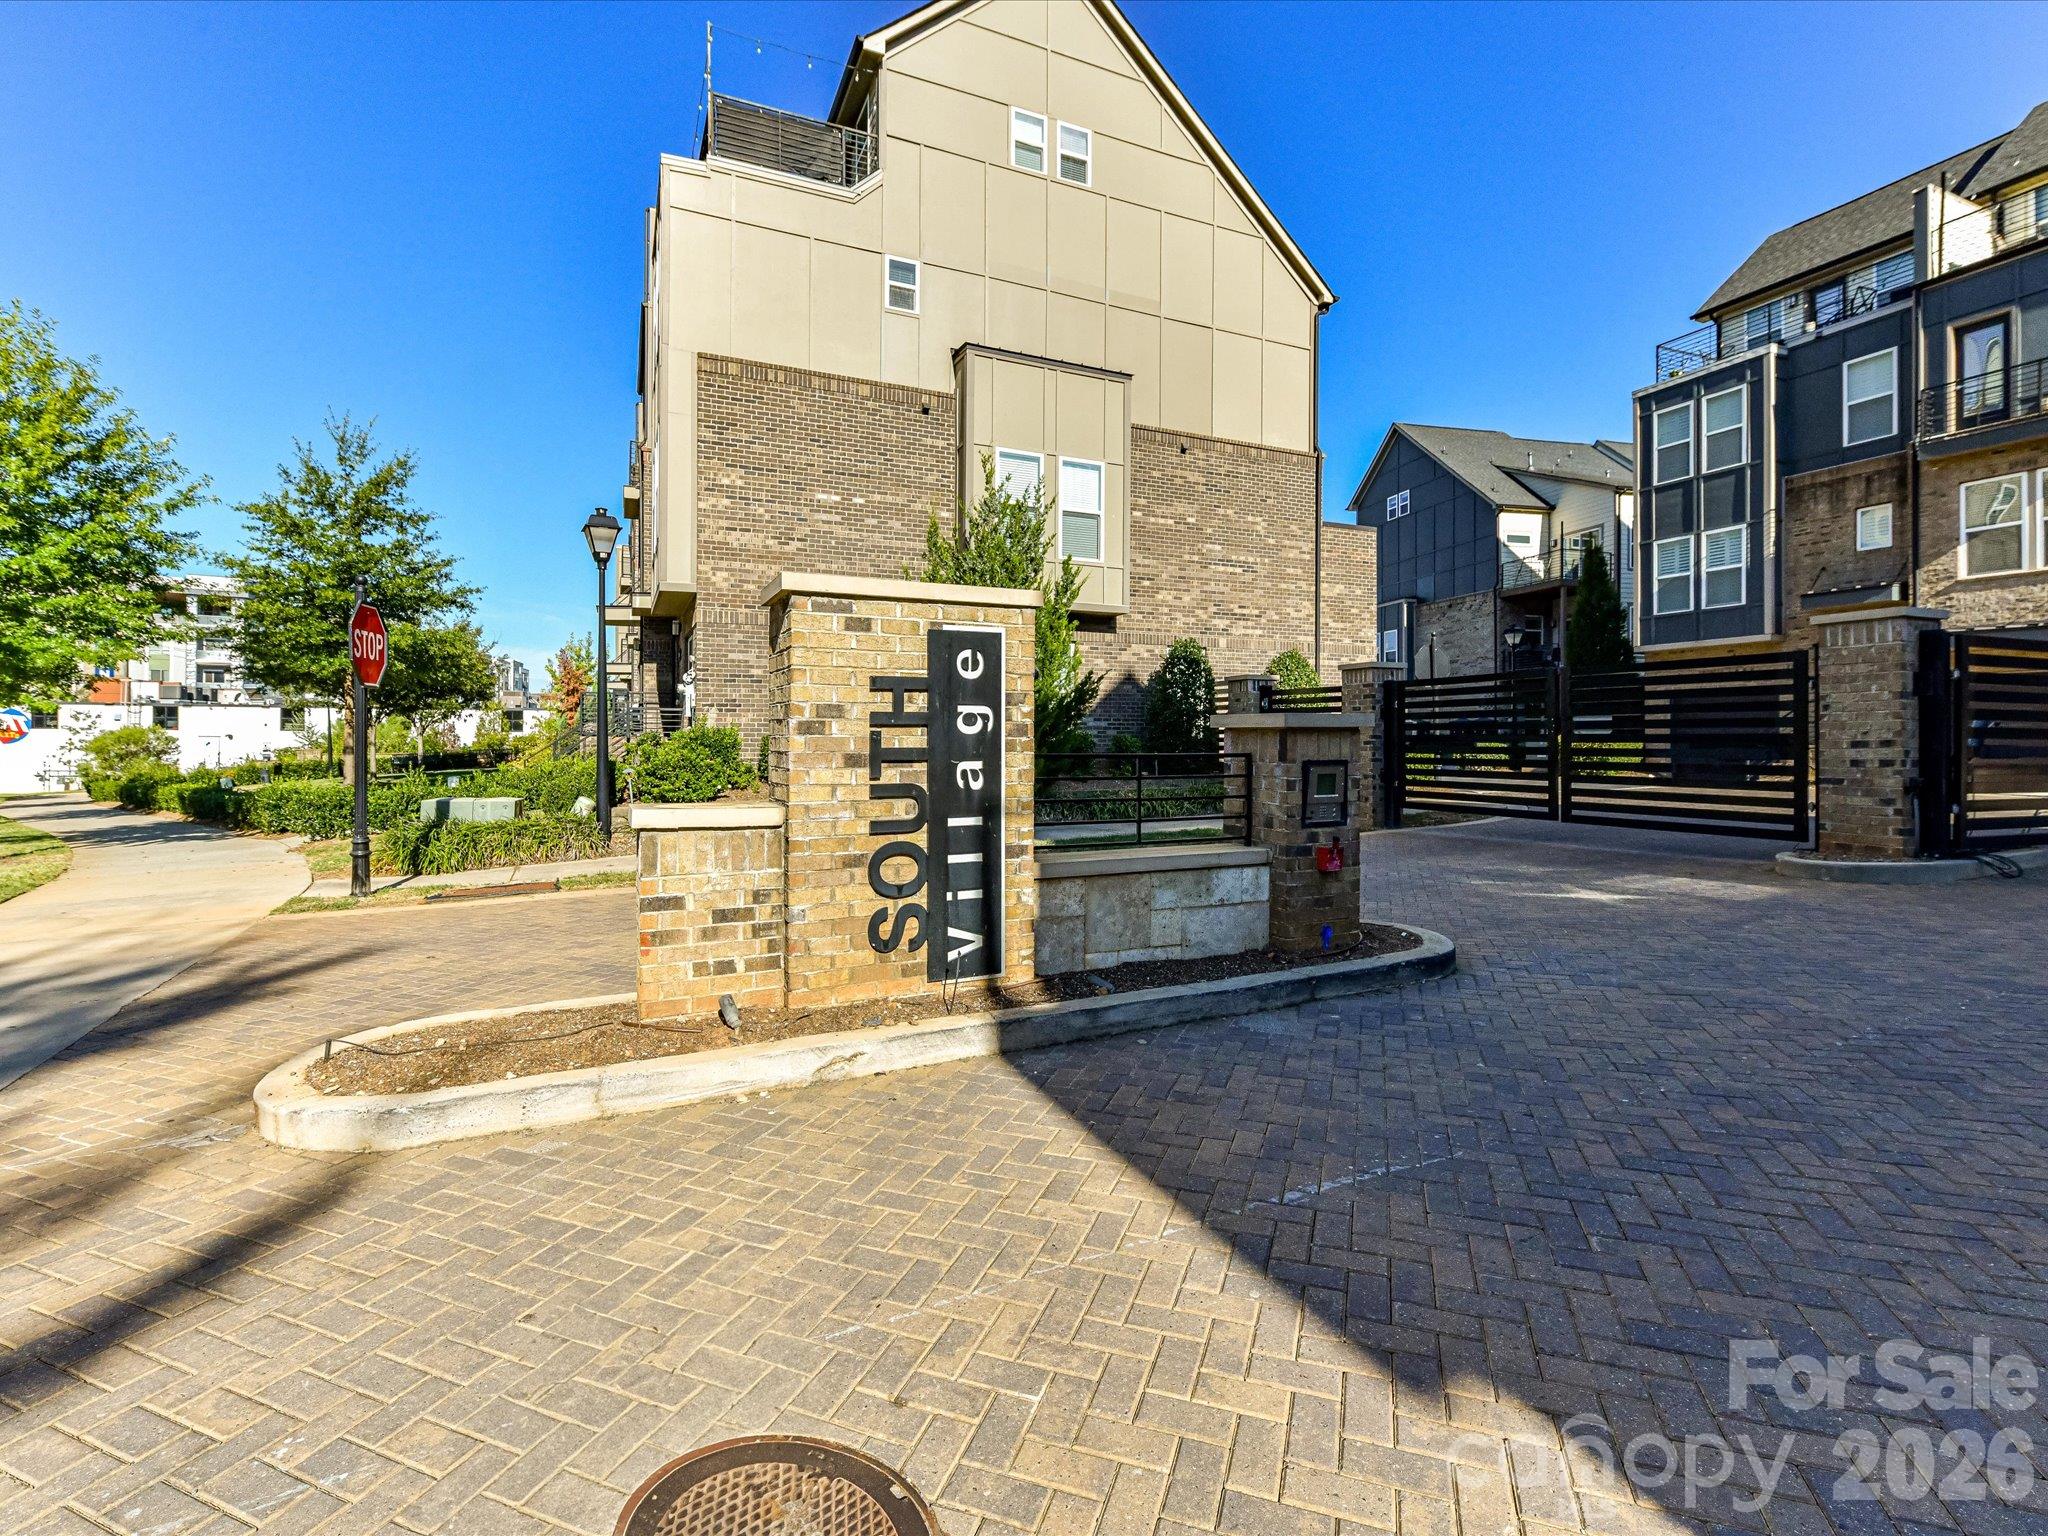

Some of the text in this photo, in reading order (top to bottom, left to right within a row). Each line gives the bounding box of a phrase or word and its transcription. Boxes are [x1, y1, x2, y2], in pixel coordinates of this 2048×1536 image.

[354, 628, 384, 661] STOP
[868, 676, 928, 954] SOUTH
[946, 649, 994, 963] village
